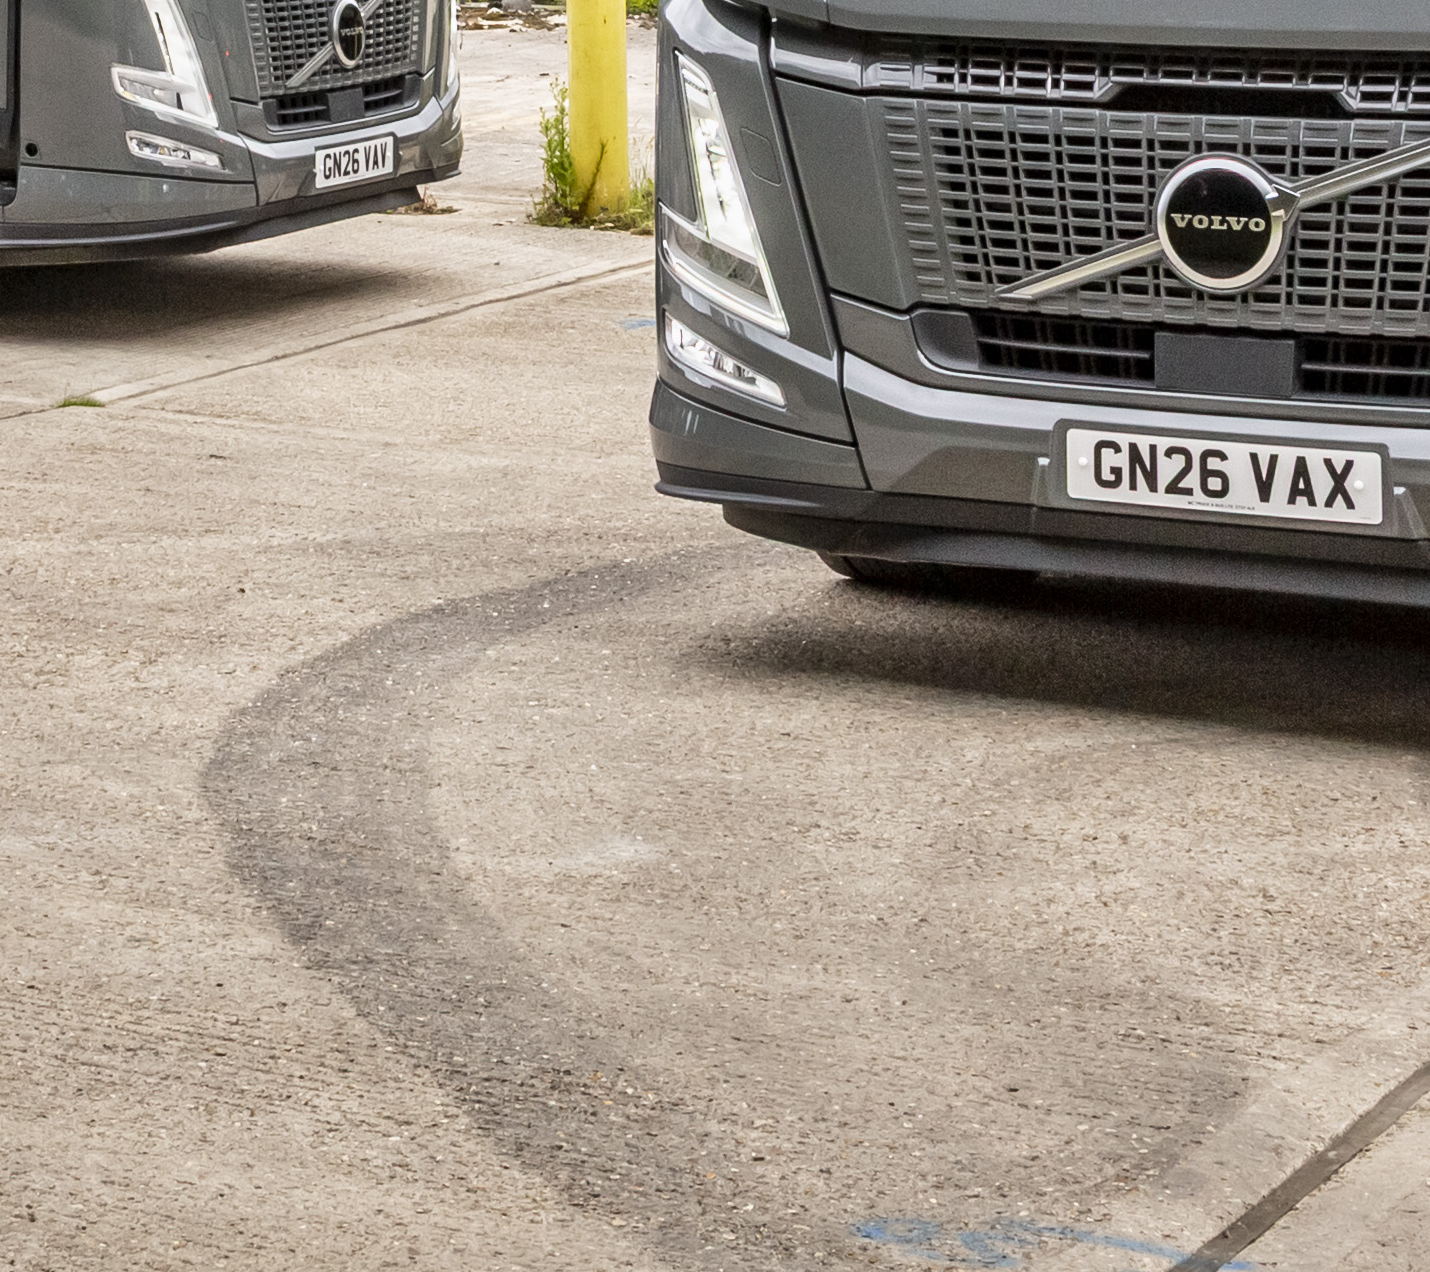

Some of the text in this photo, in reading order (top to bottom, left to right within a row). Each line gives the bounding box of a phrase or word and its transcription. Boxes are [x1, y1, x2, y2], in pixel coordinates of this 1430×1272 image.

[323, 141, 388, 180] GN26 VAV
[1170, 213, 1266, 232] VOLVO
[1093, 439, 1356, 510] GN26 VAX
